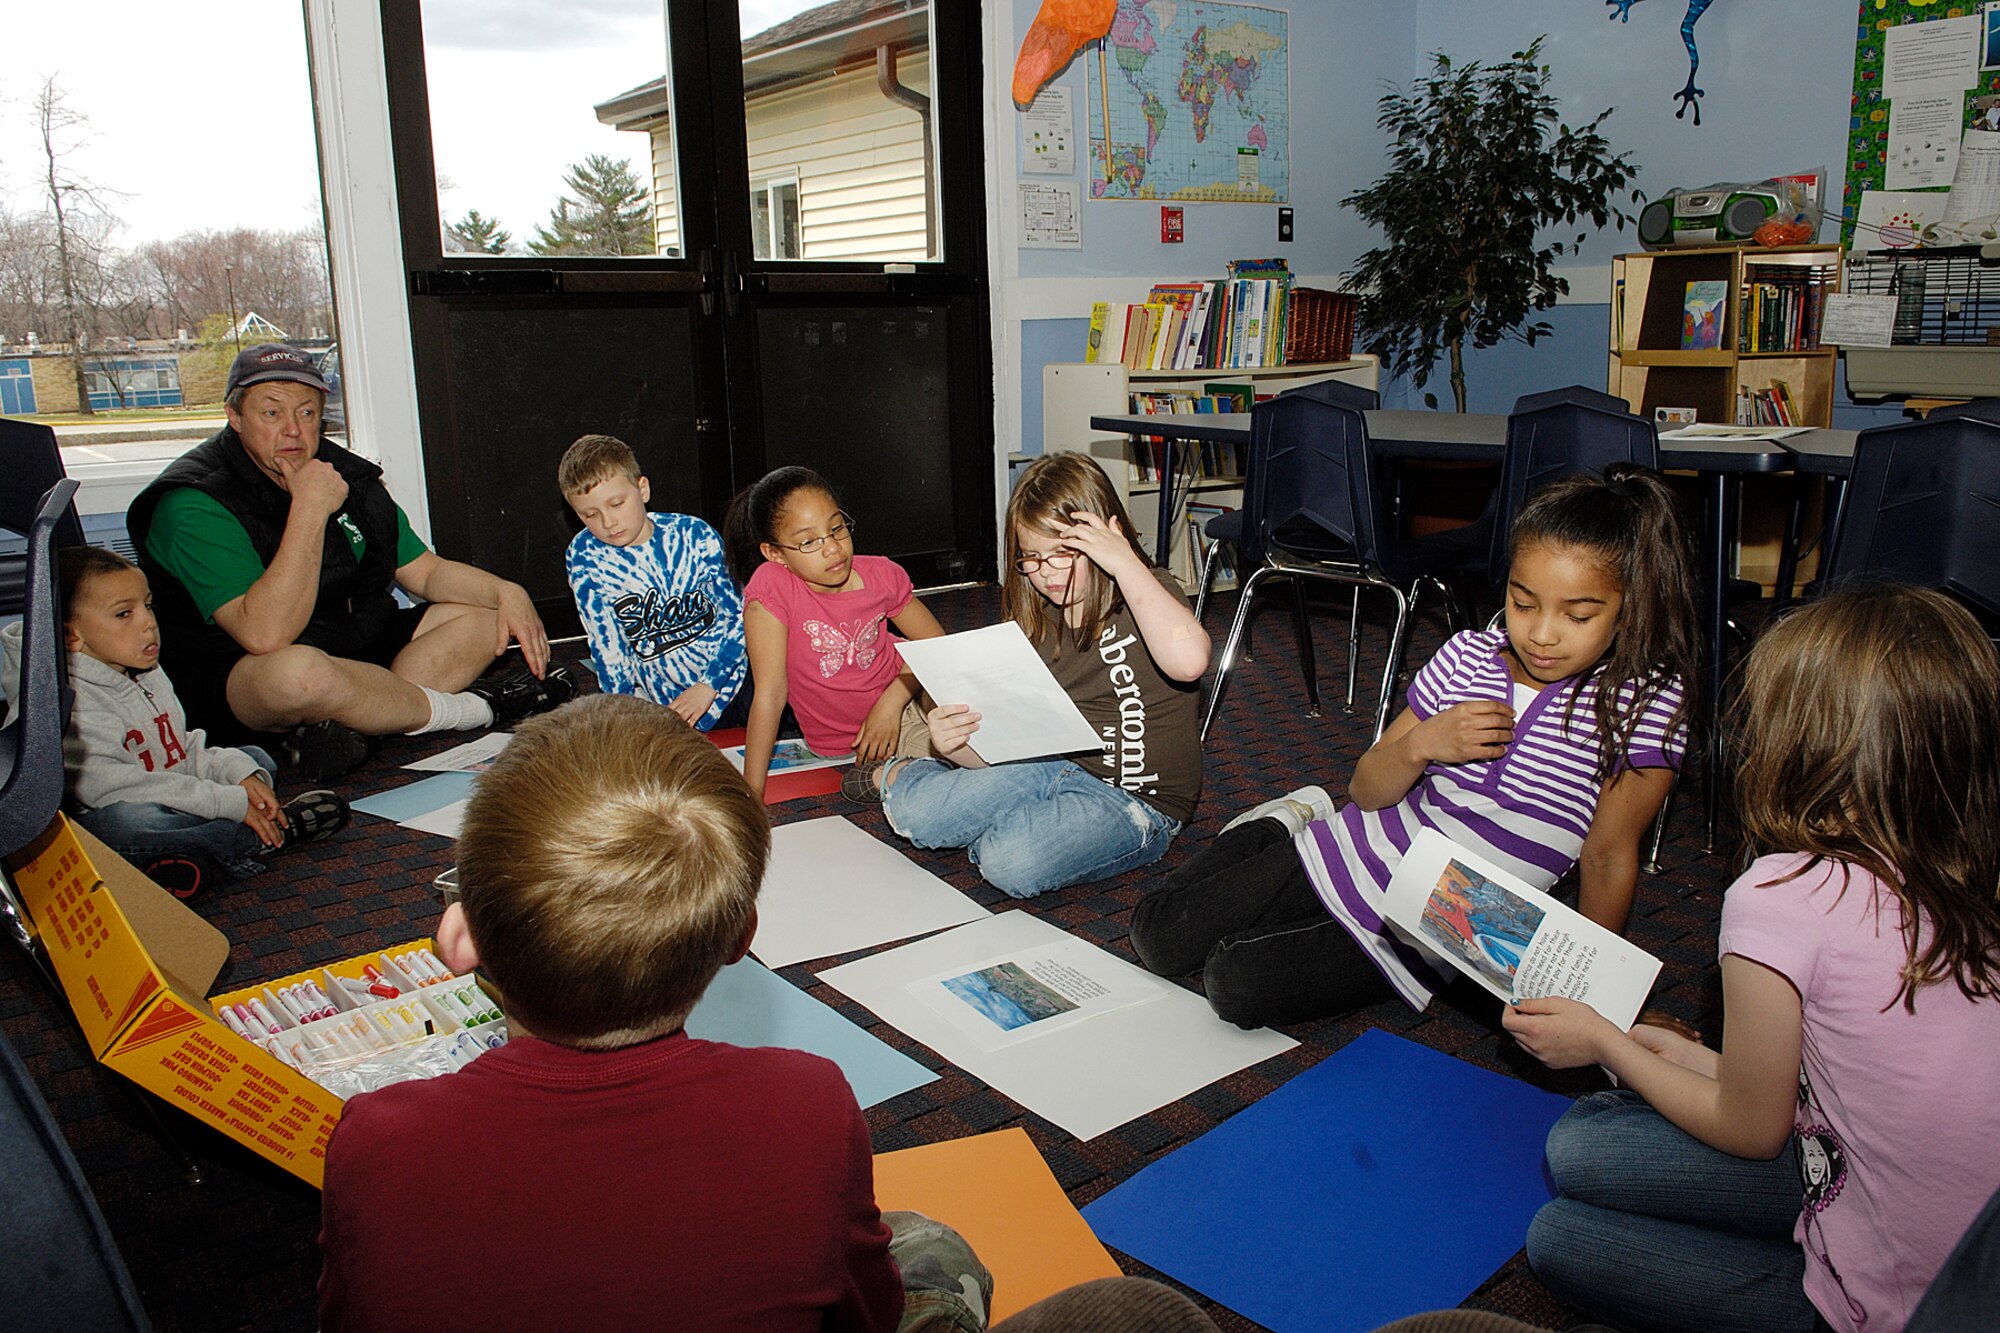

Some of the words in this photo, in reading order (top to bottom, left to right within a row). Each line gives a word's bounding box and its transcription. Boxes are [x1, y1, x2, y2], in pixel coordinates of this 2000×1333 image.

[190, 1032, 216, 1050] PURPLE
[172, 1050, 192, 1064] GRAY
[181, 1041, 209, 1060] ORANGE
[215, 1046, 237, 1063] ROYAL
[160, 1057, 179, 1072] PINK
[190, 1061, 220, 1082] DOLPHIN
[208, 1057, 228, 1073] TIGER
[241, 1064, 264, 1080] GREEN
[177, 1068, 212, 1091] FLAMINGO
[174, 1085, 200, 1103] COLORS
[236, 1089, 250, 1101] TAN
[199, 1100, 227, 1119] MARKER
[249, 1097, 271, 1112] SANDY
[293, 1096, 317, 1113] YELLOW
[289, 1107, 309, 1122] BLACK
[323, 1114, 338, 1125] OWN
[267, 1122, 293, 1140] ORANGE
[279, 1115, 301, 1131] VIOLET
[318, 1124, 334, 1136] EEN
[257, 1134, 287, 1154] ASSORTED
[314, 1136, 329, 1147] LUE
[286, 1151, 296, 1160] 16
[310, 1147, 323, 1158] RED
